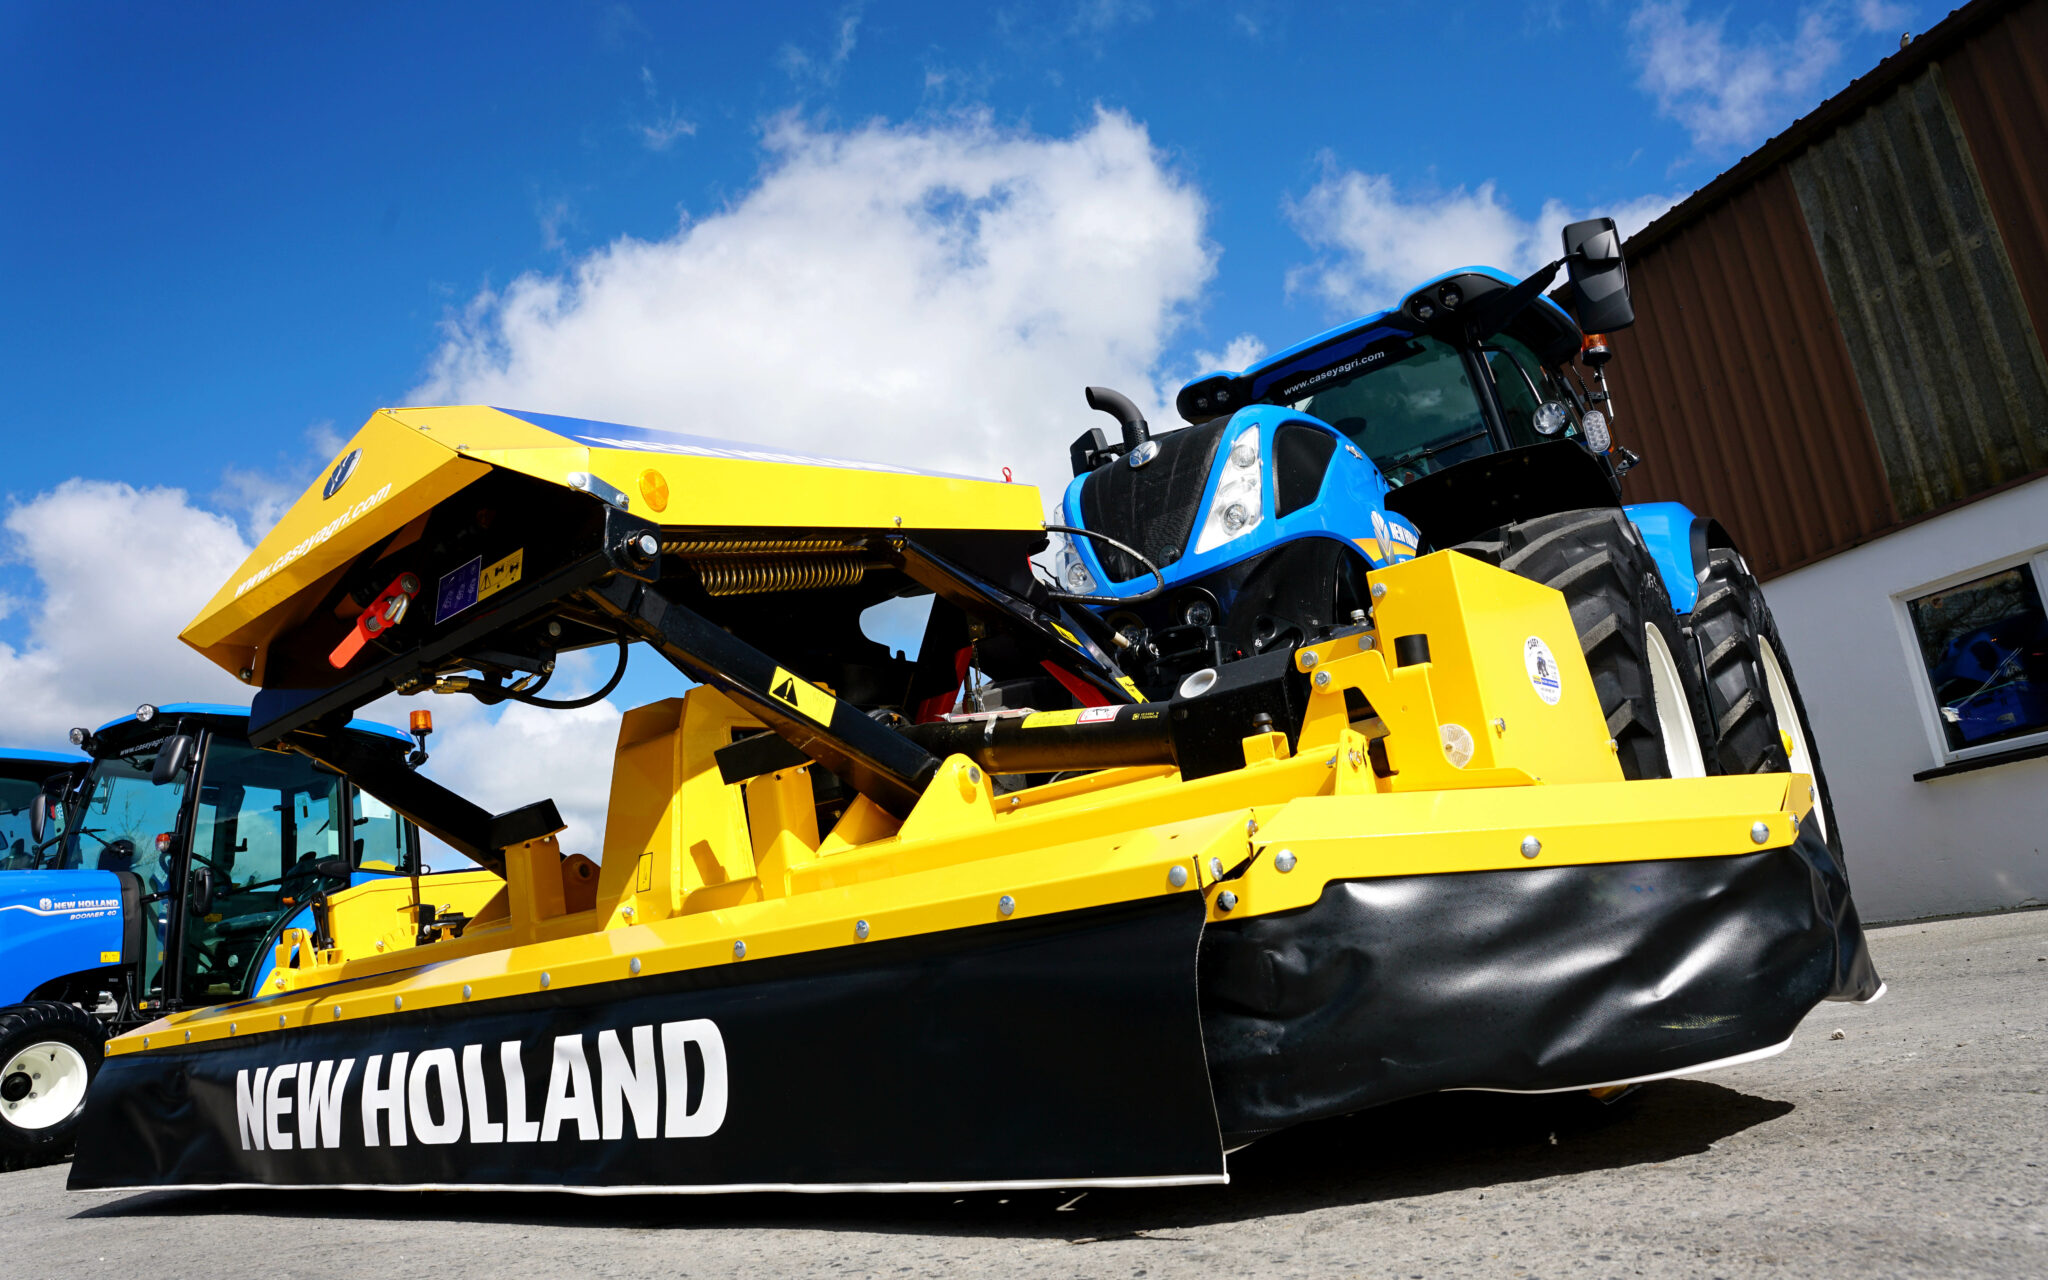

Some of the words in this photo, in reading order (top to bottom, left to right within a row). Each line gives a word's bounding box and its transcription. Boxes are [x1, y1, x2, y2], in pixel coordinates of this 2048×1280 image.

[1283, 351, 1386, 396] www.caseyagri.com
[234, 482, 393, 599] www.caseyagri.com
[53, 901, 76, 910] NEW
[77, 899, 119, 908] HOLLAND
[69, 911, 105, 921] BOOMER
[236, 1057, 356, 1151] NEW
[361, 1018, 729, 1148] HOLLAND
